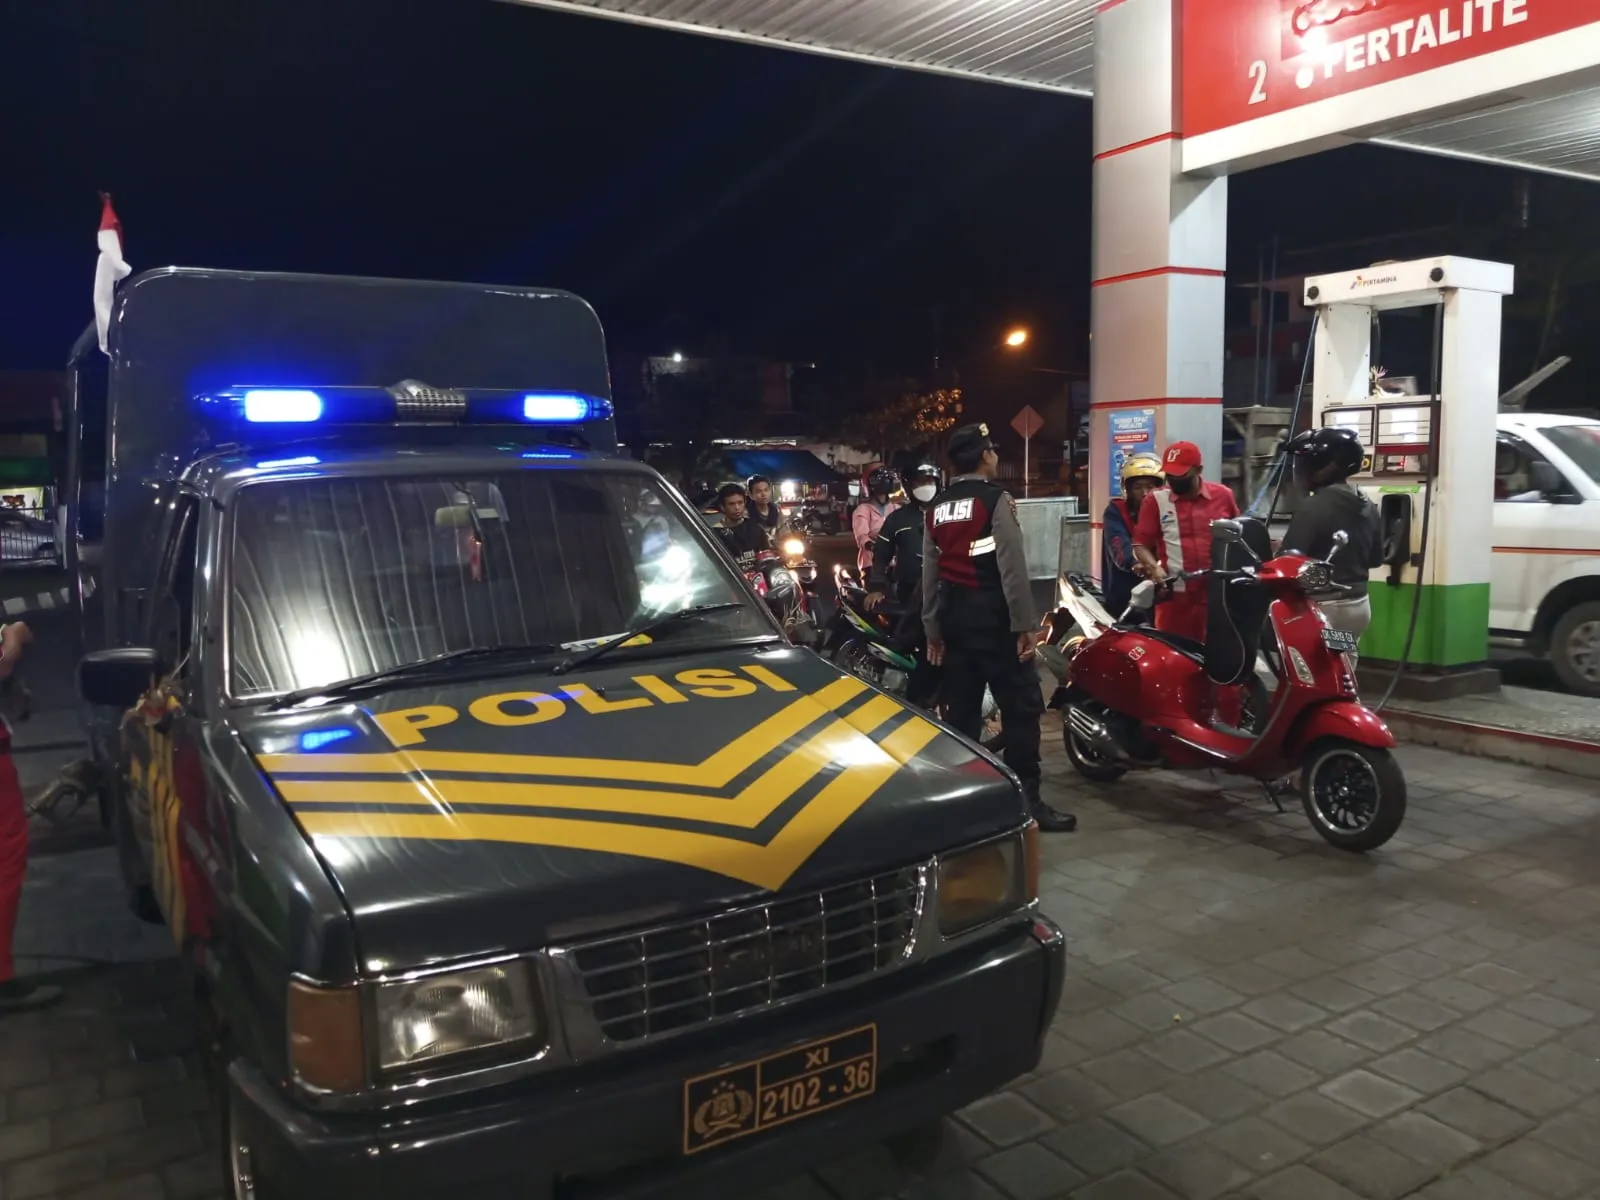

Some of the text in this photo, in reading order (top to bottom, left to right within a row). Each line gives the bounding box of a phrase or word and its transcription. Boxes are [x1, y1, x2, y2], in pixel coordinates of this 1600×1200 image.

[1248, 60, 1267, 104] 2
[933, 499, 974, 525] POLISI
[374, 664, 798, 747] POLISI
[805, 1047, 830, 1068] XI
[763, 1076, 821, 1120] 2102
[844, 1060, 870, 1093] 36
